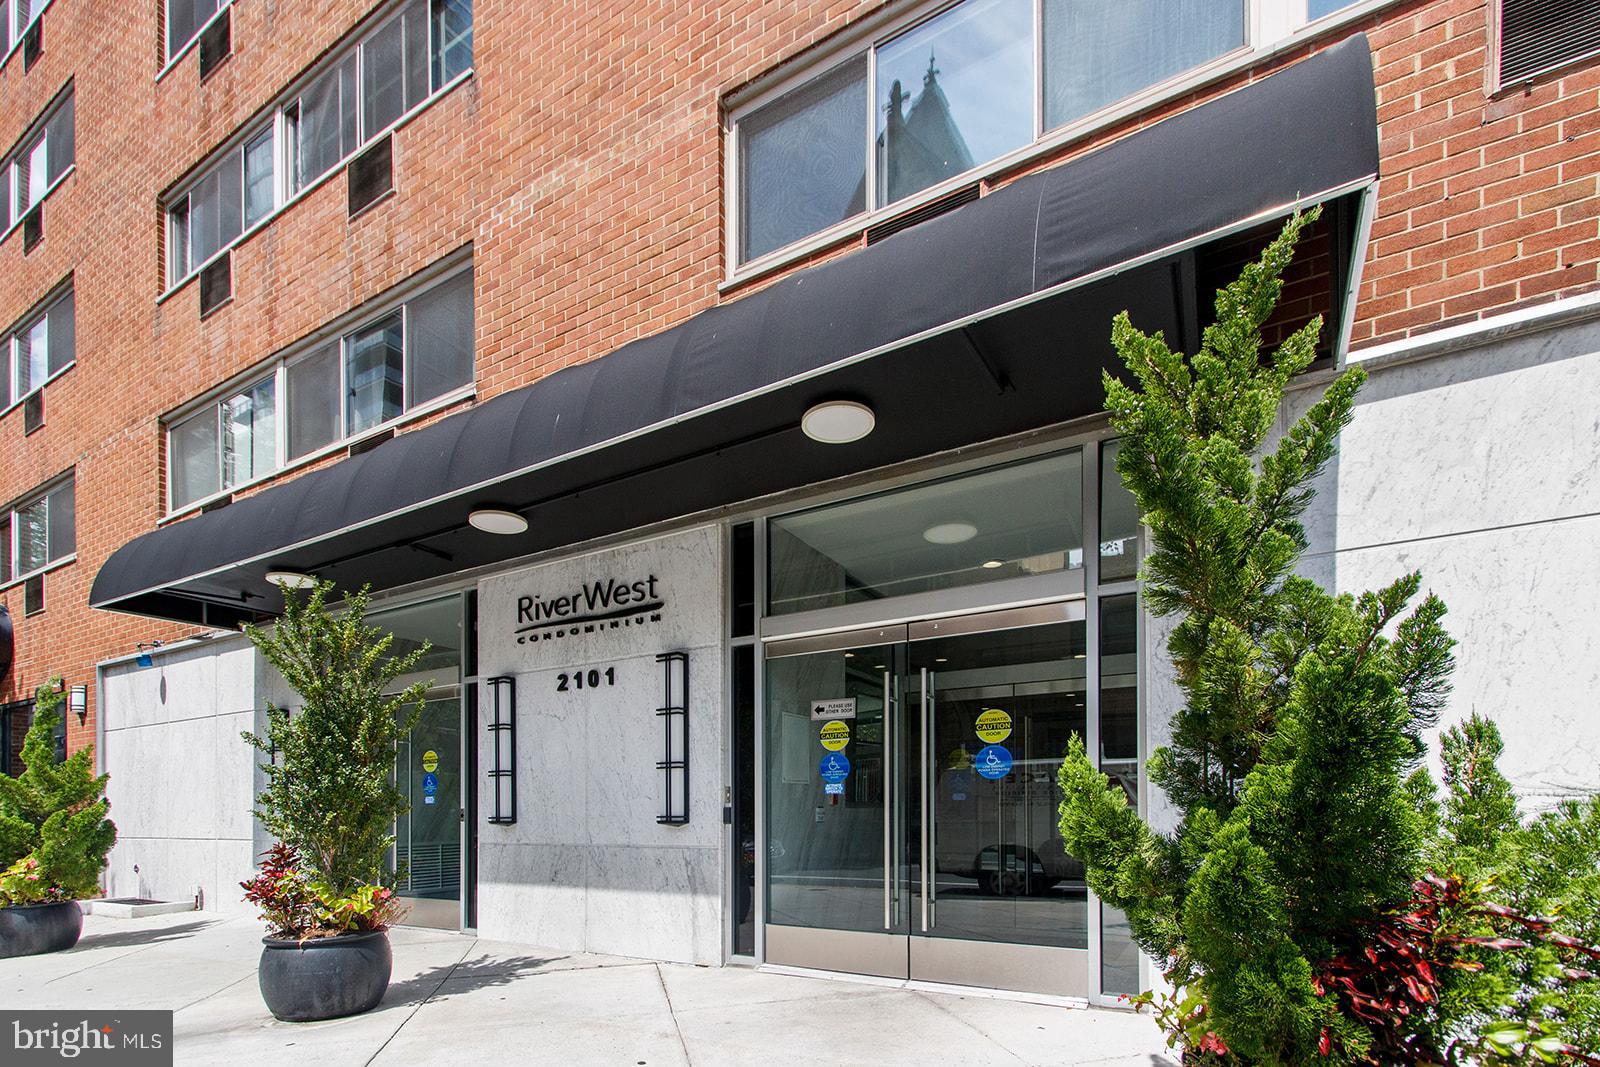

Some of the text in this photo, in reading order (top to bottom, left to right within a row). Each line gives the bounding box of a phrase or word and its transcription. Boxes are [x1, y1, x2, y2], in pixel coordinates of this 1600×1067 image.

[517, 574, 659, 624] RiverWest
[516, 613, 662, 645] CONDOMINIUM
[556, 666, 615, 692] 2101
[820, 732, 849, 740] CAUTION
[976, 722, 1011, 731] CAUTION
